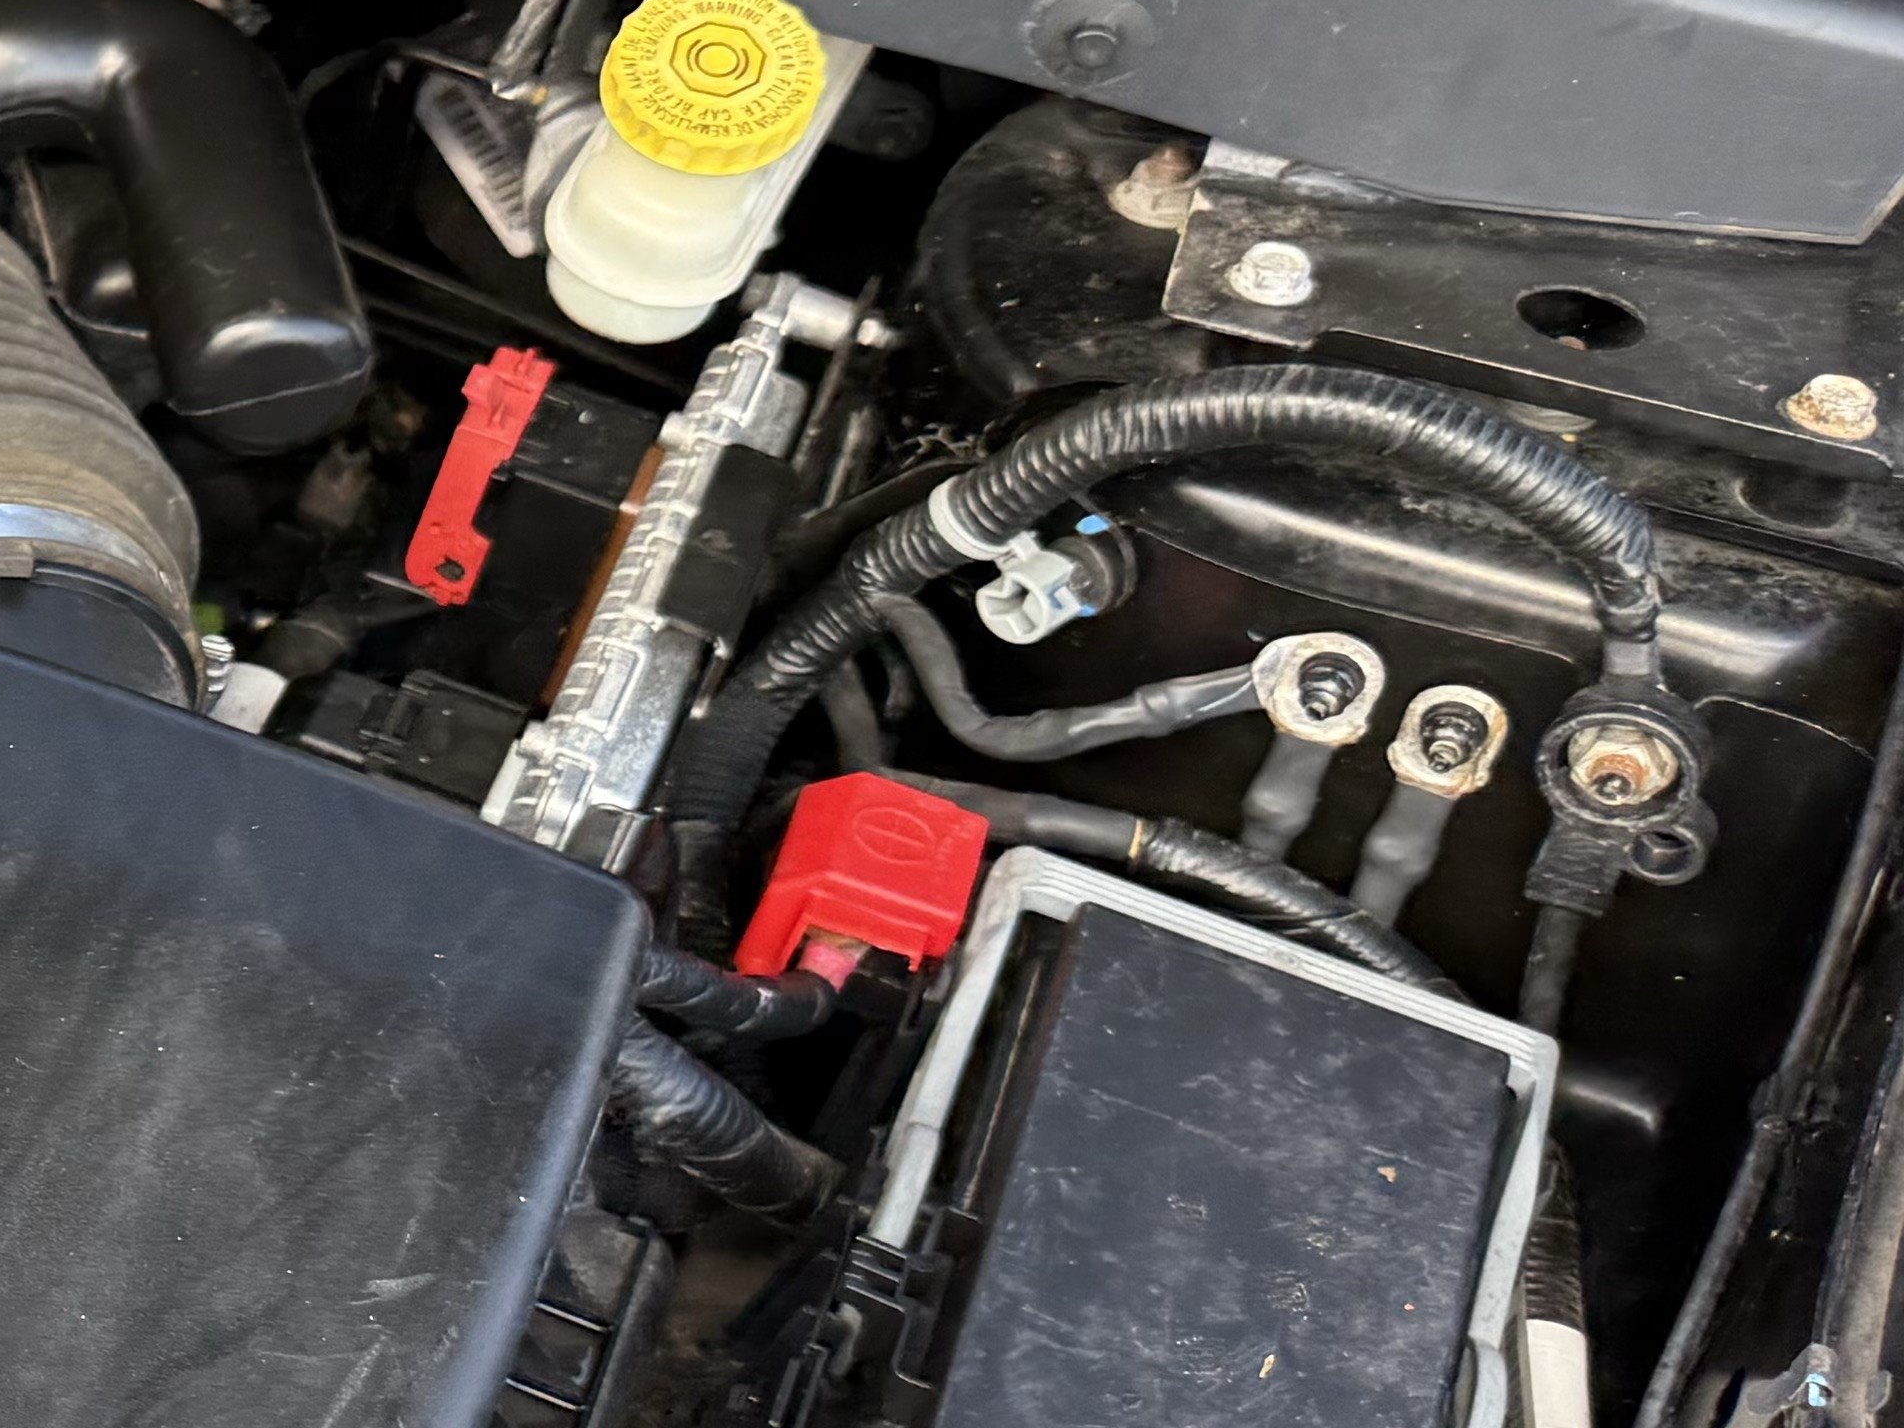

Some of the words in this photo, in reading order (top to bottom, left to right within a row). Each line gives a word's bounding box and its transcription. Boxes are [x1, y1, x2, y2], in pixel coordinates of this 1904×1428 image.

[765, 28, 795, 71] CLEAN
[643, 68, 695, 115] BEFORE
[742, 78, 792, 117] FILLER
[697, 107, 733, 122] CAP
